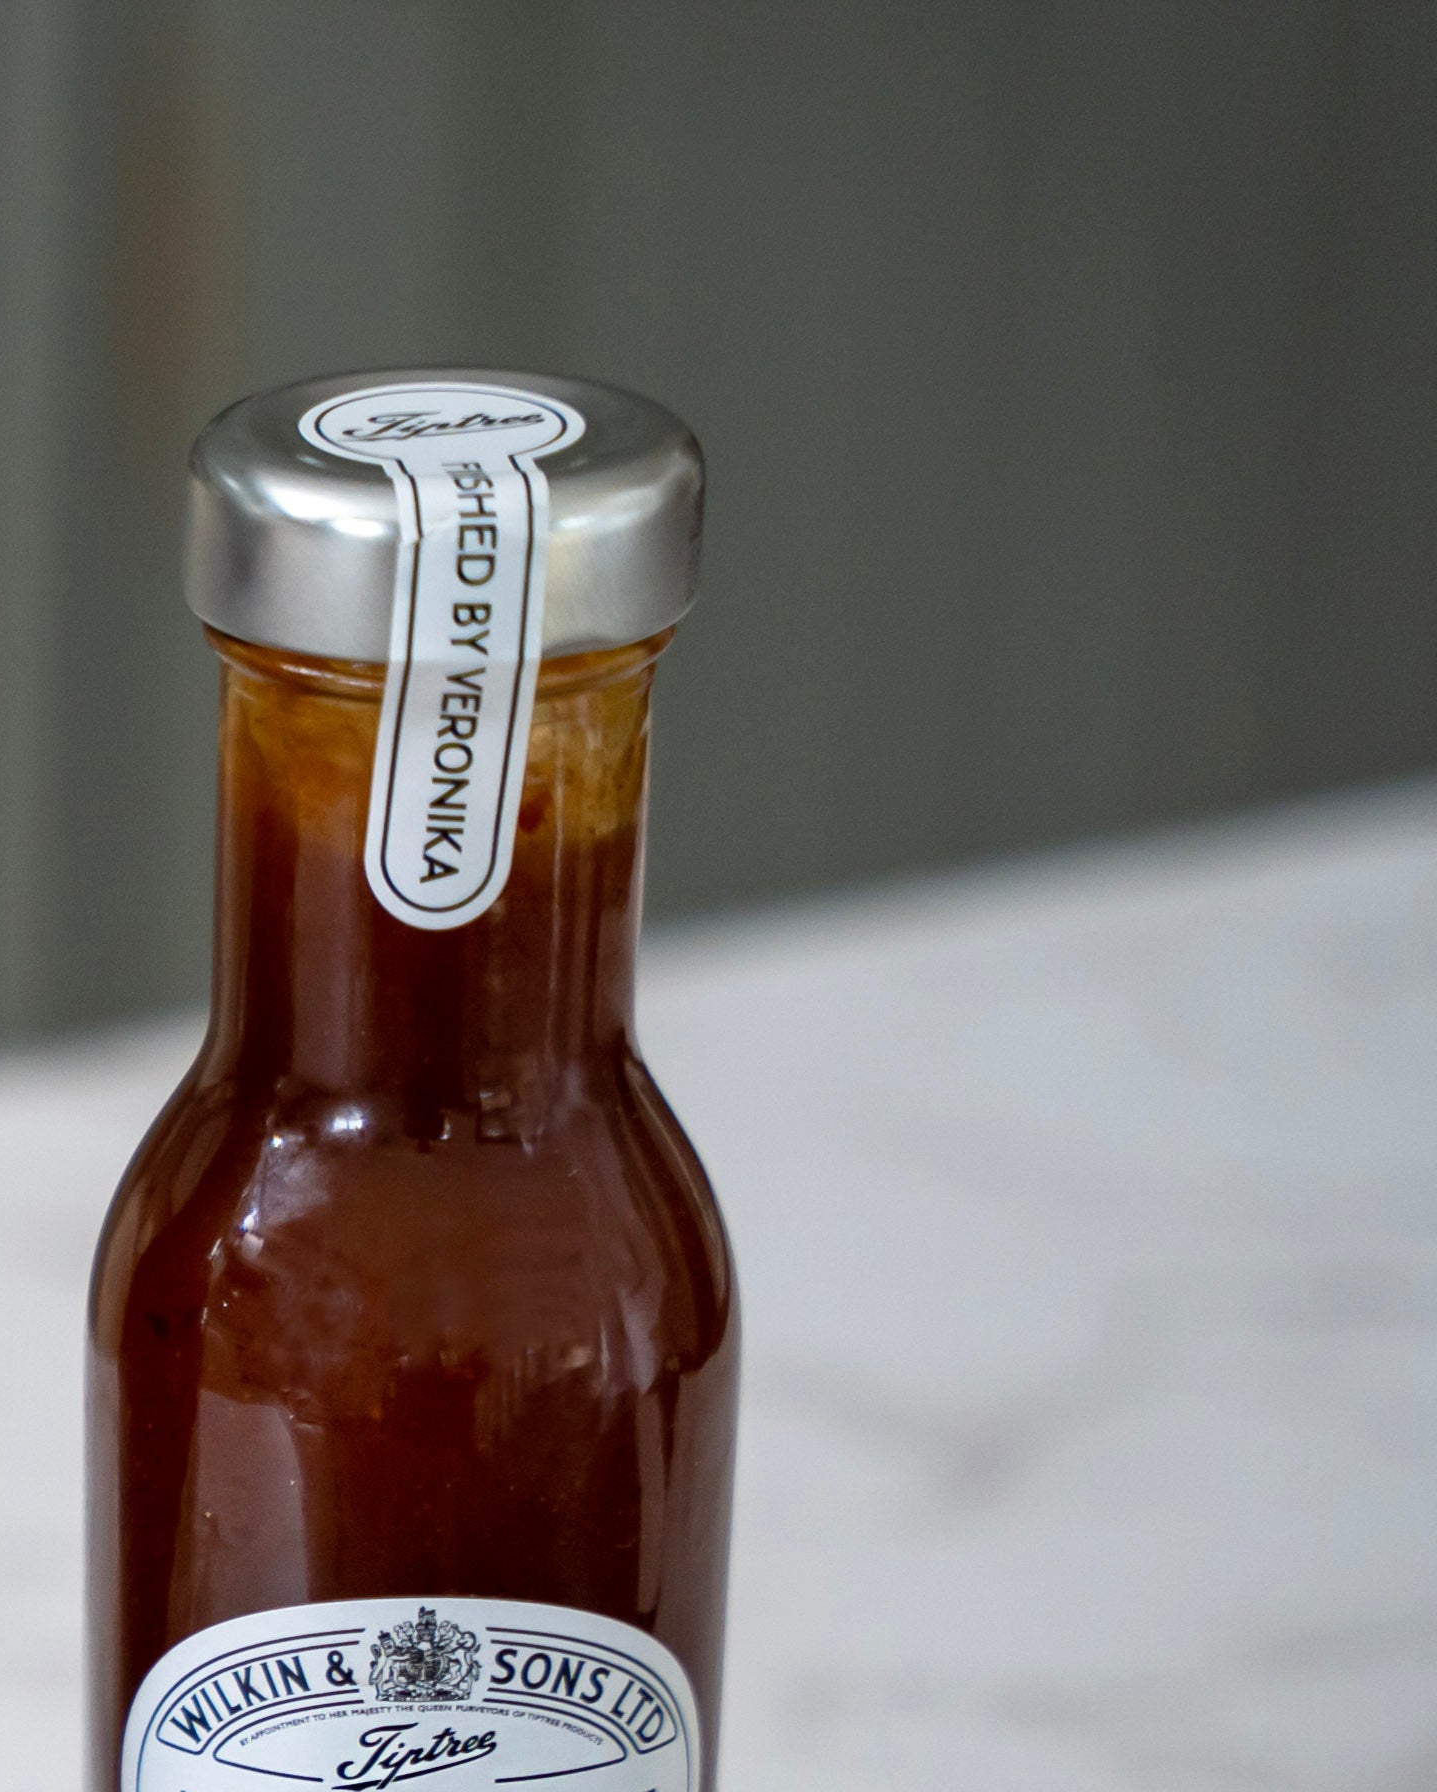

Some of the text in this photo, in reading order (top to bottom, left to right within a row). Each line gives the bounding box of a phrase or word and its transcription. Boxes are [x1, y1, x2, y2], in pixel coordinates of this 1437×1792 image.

[336, 412, 545, 442] Tiptree
[450, 603, 492, 658] BY
[419, 667, 487, 885] VERONIKA
[170, 1648, 667, 1745] WILKIN & SONS LTD
[251, 1716, 310, 1741] APPOINTMENT
[313, 1713, 325, 1721] TO
[329, 1710, 348, 1718] HER
[351, 1706, 392, 1717] MAJESTY
[418, 1704, 452, 1713] QUEEN
[332, 1722, 496, 1790] Tiptree
